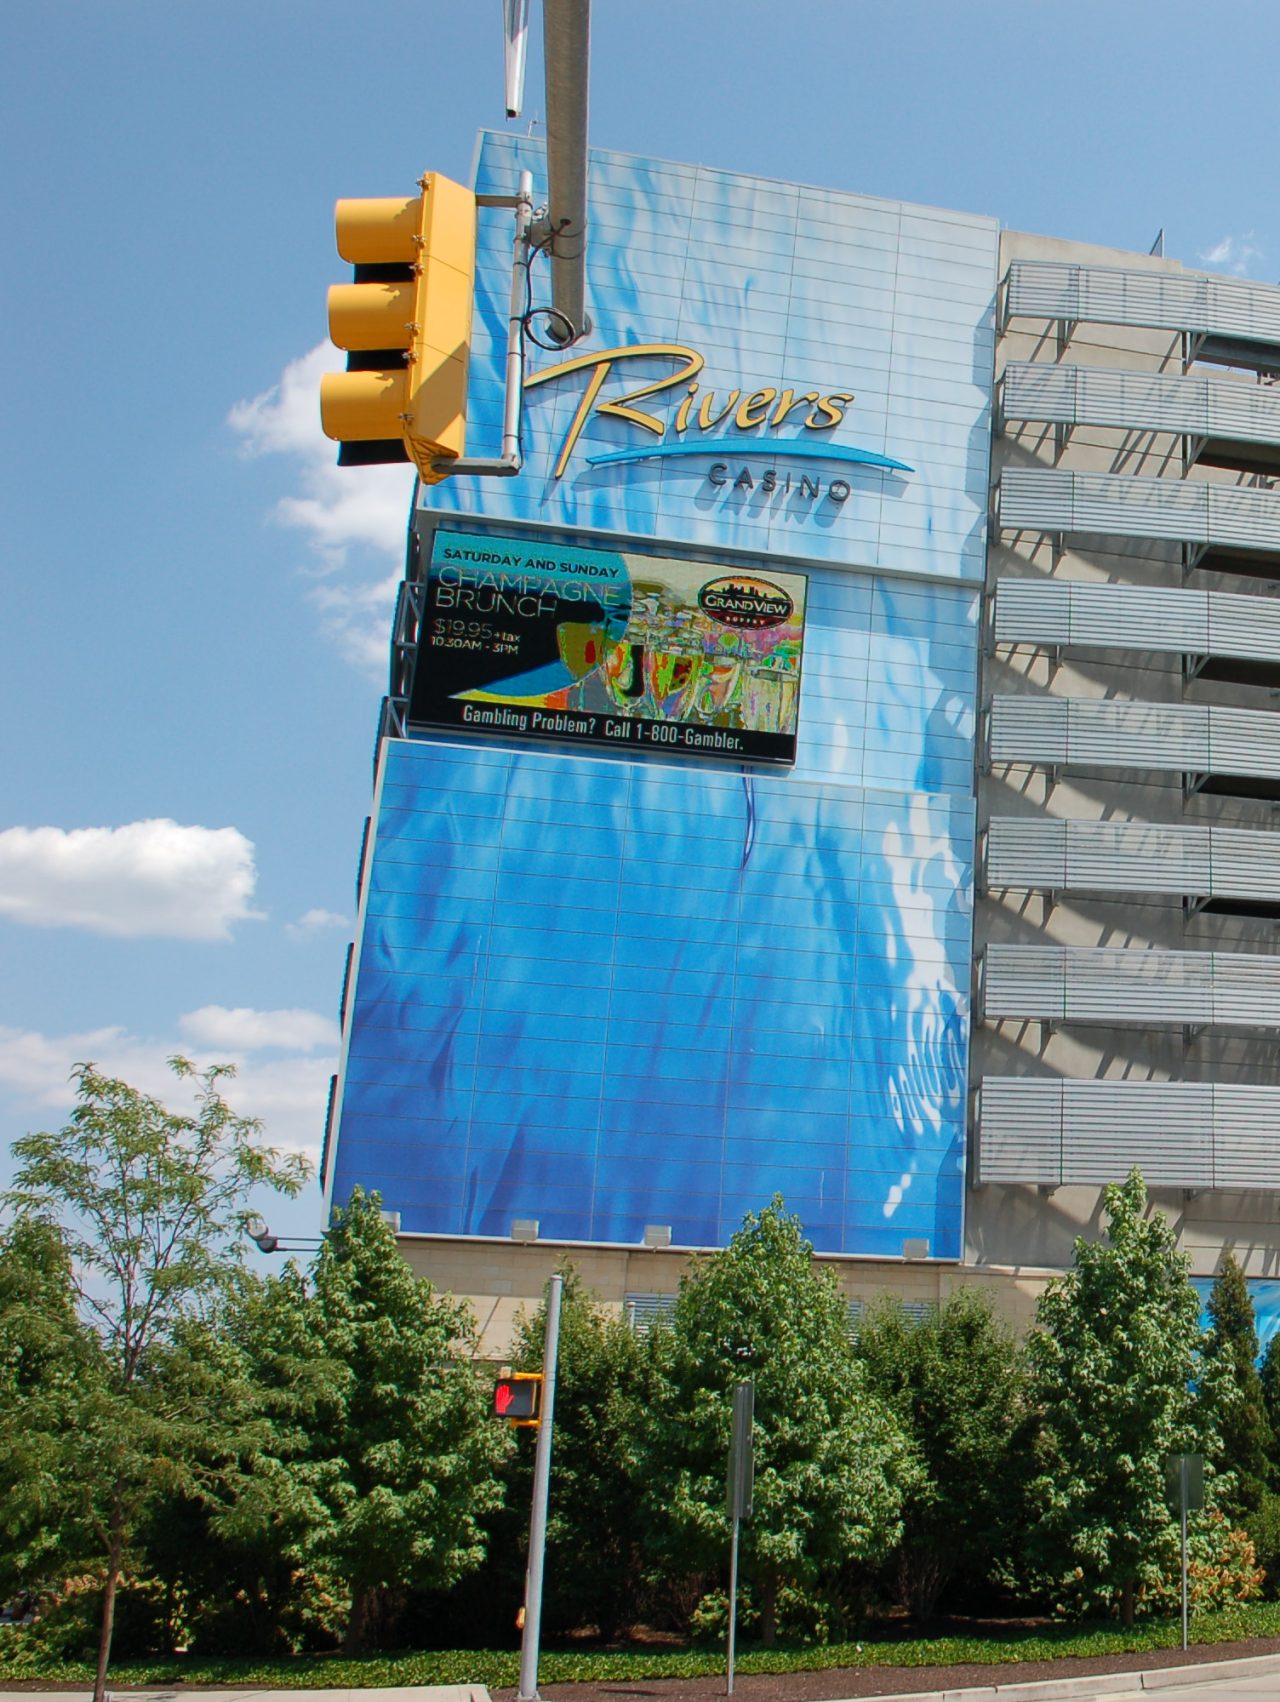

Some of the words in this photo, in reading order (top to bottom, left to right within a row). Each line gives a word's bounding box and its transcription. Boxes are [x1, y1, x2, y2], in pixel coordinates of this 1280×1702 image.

[523, 343, 856, 480] Rivers
[708, 464, 851, 501] CASINO
[444, 548, 521, 566] SATURDAY
[525, 559, 556, 571] AND
[560, 563, 620, 578] SUNDAY
[436, 587, 558, 618] BRUNCH
[438, 566, 621, 606] CHAMPAGNE
[433, 618, 493, 639] $19.95
[463, 704, 527, 731] Gambling
[532, 711, 595, 735] Problem?
[605, 720, 630, 738] Call
[636, 723, 744, 750] 1-800-Gambler.
